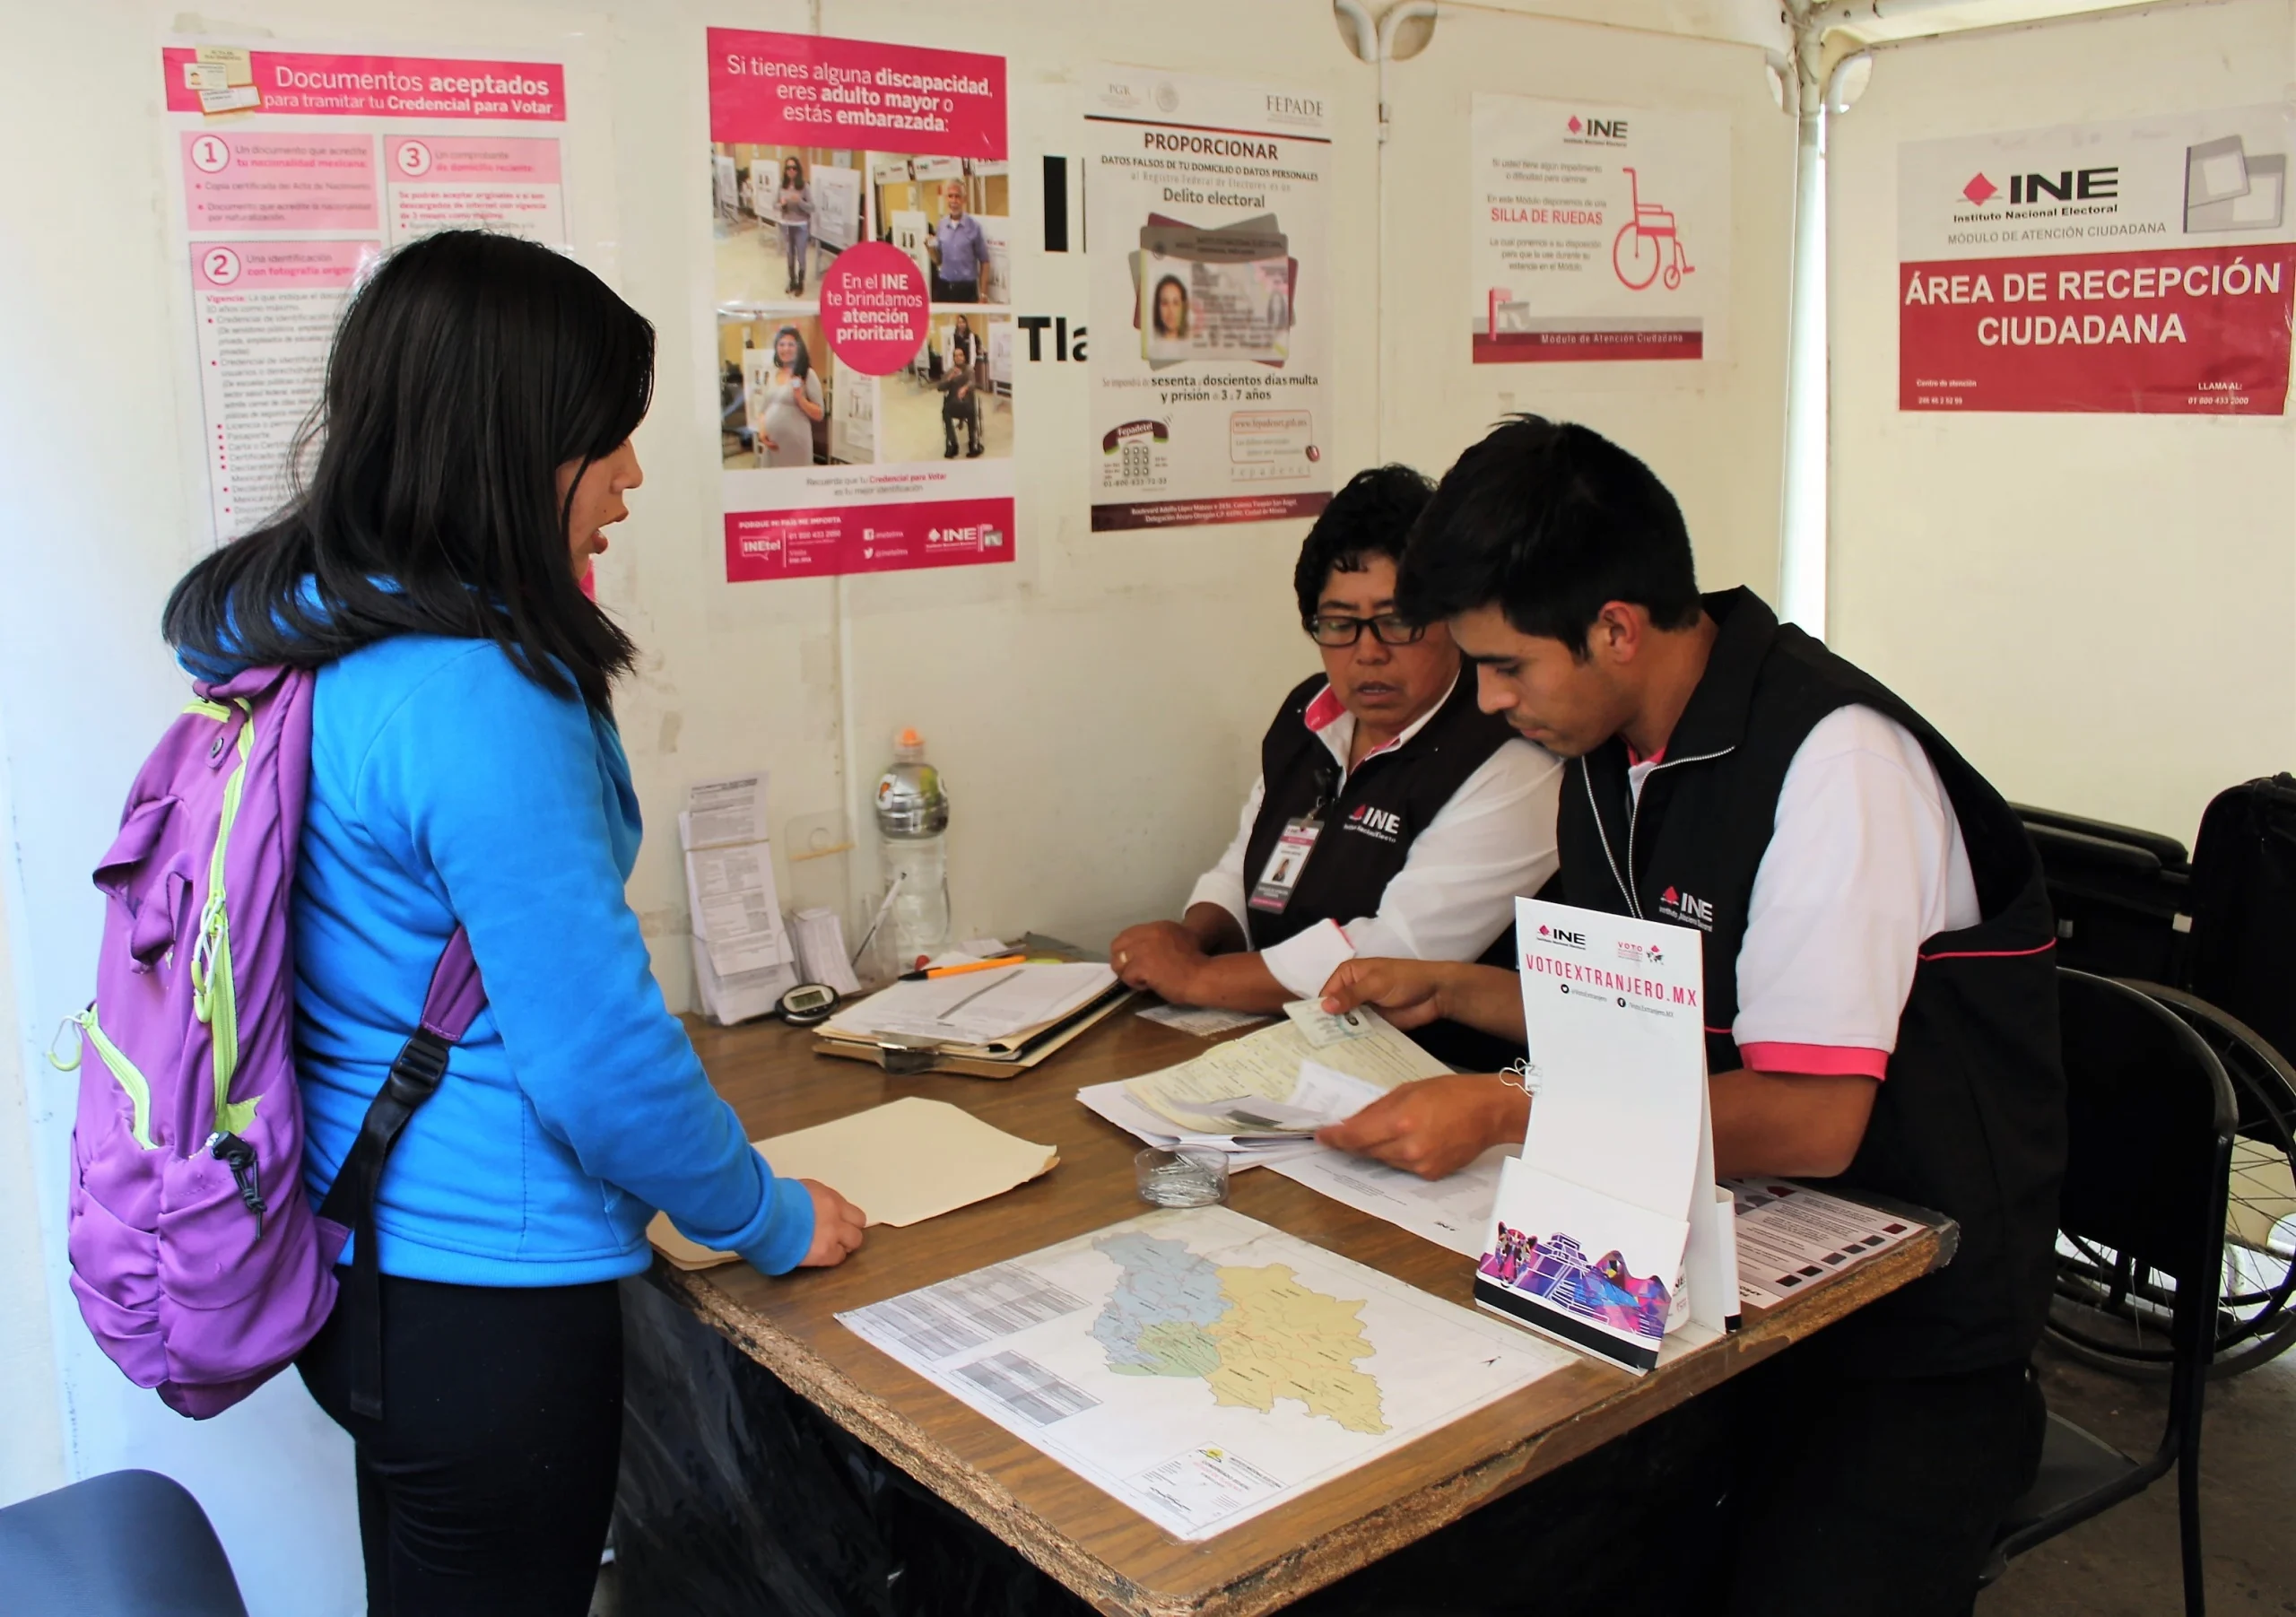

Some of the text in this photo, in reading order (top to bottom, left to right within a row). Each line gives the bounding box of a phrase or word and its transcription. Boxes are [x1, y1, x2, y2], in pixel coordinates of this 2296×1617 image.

[274, 65, 550, 98] Documentos aceptados
[726, 54, 994, 99] Si tienes alguna discapacidad,
[776, 83, 954, 115] eres adulto mayor o
[1109, 83, 1131, 96] PGR
[264, 93, 553, 115] para tramitar tu Credencial para Votar
[1265, 94, 1324, 117] FEPADE
[782, 101, 950, 133] estás embarazada:
[1587, 118, 1629, 139] INE
[204, 141, 217, 163] 1
[251, 145, 308, 155] documento
[1144, 132, 1279, 161] PROPORCIONAR
[405, 147, 421, 168] 3
[1100, 154, 1319, 182] DATOS FALSOS DE TU DOMICILIO O DATOS PERSONALES
[1182, 174, 1213, 186] Federal
[2009, 167, 2118, 204] INE
[1162, 187, 1266, 209] Delito electoral
[1490, 207, 1604, 225] SILLA DE RUEDAS
[1952, 204, 2118, 224] Instituto Nacional Electoral
[1947, 222, 2167, 246] MÓDULO DE ATENCIÓN CIUDADANA
[213, 254, 229, 276] 2
[842, 272, 909, 291] En el INE
[1904, 256, 2282, 306] ÁREA DE RECEPCIÓN
[827, 290, 923, 309] te brindamos
[842, 308, 909, 325] atención
[836, 325, 914, 344] prioritaria
[1541, 332, 1683, 344] Módulo de Atención Ciudadana
[1976, 313, 2187, 348] CIUDADANA
[1151, 376, 1196, 387] sesenta
[1203, 374, 1262, 387] doscientos
[1264, 373, 1287, 387] días
[1289, 373, 1319, 386] multa
[2197, 381, 2228, 391] LLAMA
[1160, 392, 1169, 404] y
[1170, 387, 1210, 404] prisión
[1221, 388, 1229, 401] 3
[1235, 388, 1243, 400] 7
[1245, 387, 1272, 400] años
[1118, 422, 1153, 437] Fepadetel
[869, 474, 909, 484] Credencial
[910, 474, 927, 485] para
[738, 520, 770, 529] PORQUE
[810, 516, 842, 526] IMPORTA
[942, 526, 977, 542] INE
[744, 539, 781, 552] INEtel
[1361, 806, 1401, 835] INE
[1680, 892, 1713, 923] INE
[1552, 927, 1587, 946] INE
[1617, 941, 1643, 953] VOTO
[1525, 952, 1698, 1008] VOTOEXTRANJERO.MX
